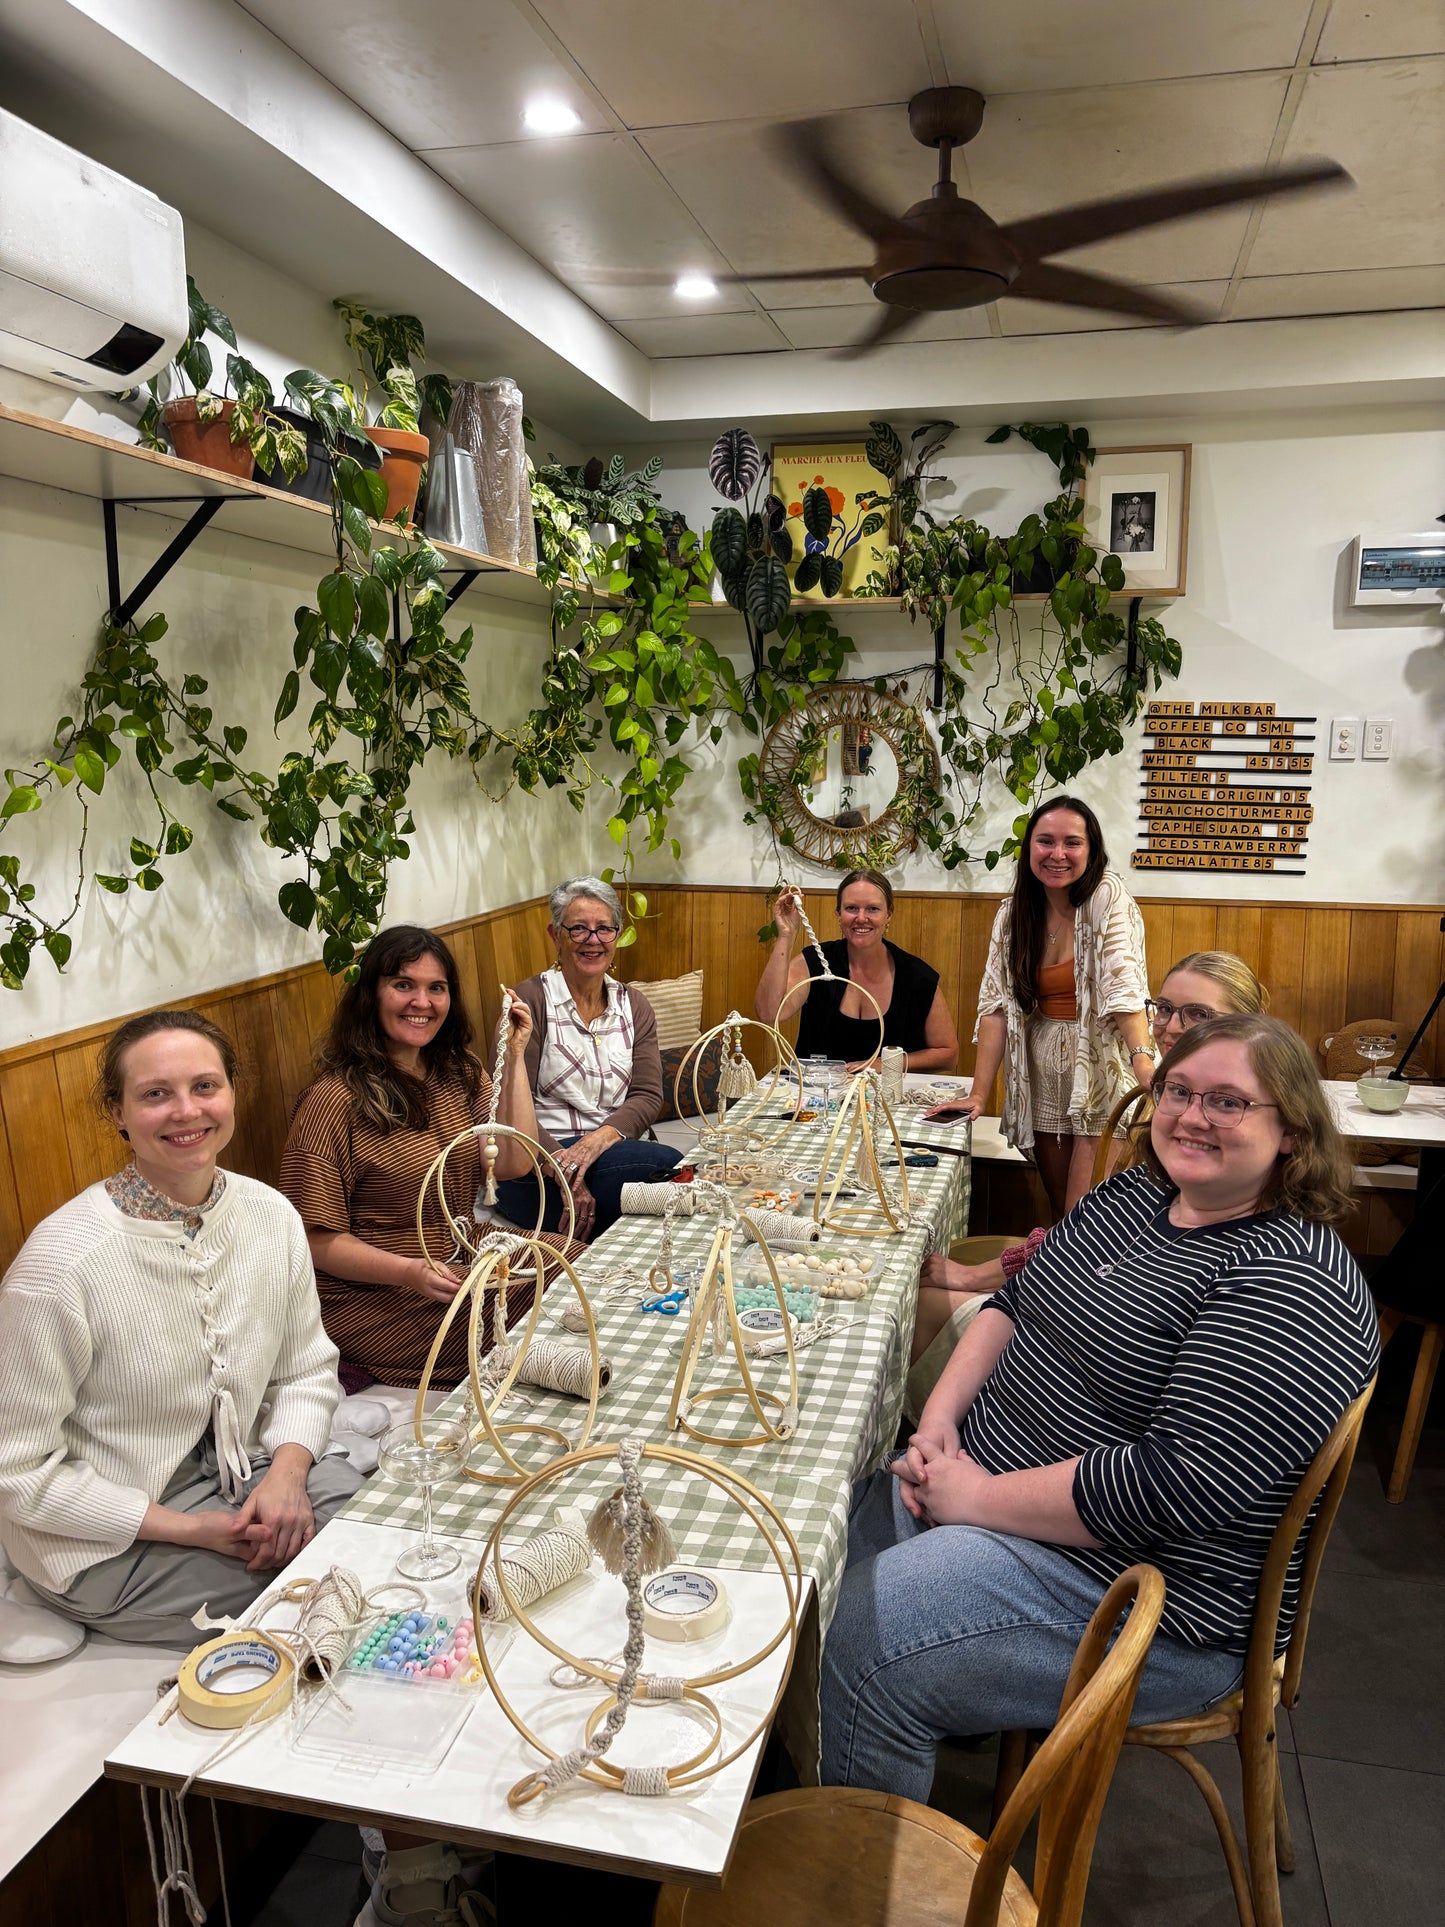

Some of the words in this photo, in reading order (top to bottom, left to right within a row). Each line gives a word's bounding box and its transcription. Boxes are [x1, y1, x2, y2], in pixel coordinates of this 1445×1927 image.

[824, 455, 843, 464] AUX
[1150, 704, 1192, 714] @THE
[1201, 705, 1274, 716] MILKBAR
[1148, 721, 1211, 732] COFFEE
[1225, 722, 1246, 732] CO
[1260, 721, 1292, 733] SML
[1158, 739, 1210, 749] BLACK
[1145, 755, 1194, 765] WHITE
[1151, 772, 1209, 783] FILTER
[1219, 773, 1226, 782] 5
[1150, 789, 1209, 800] SINGLE
[1216, 790, 1275, 801] ORIGIN
